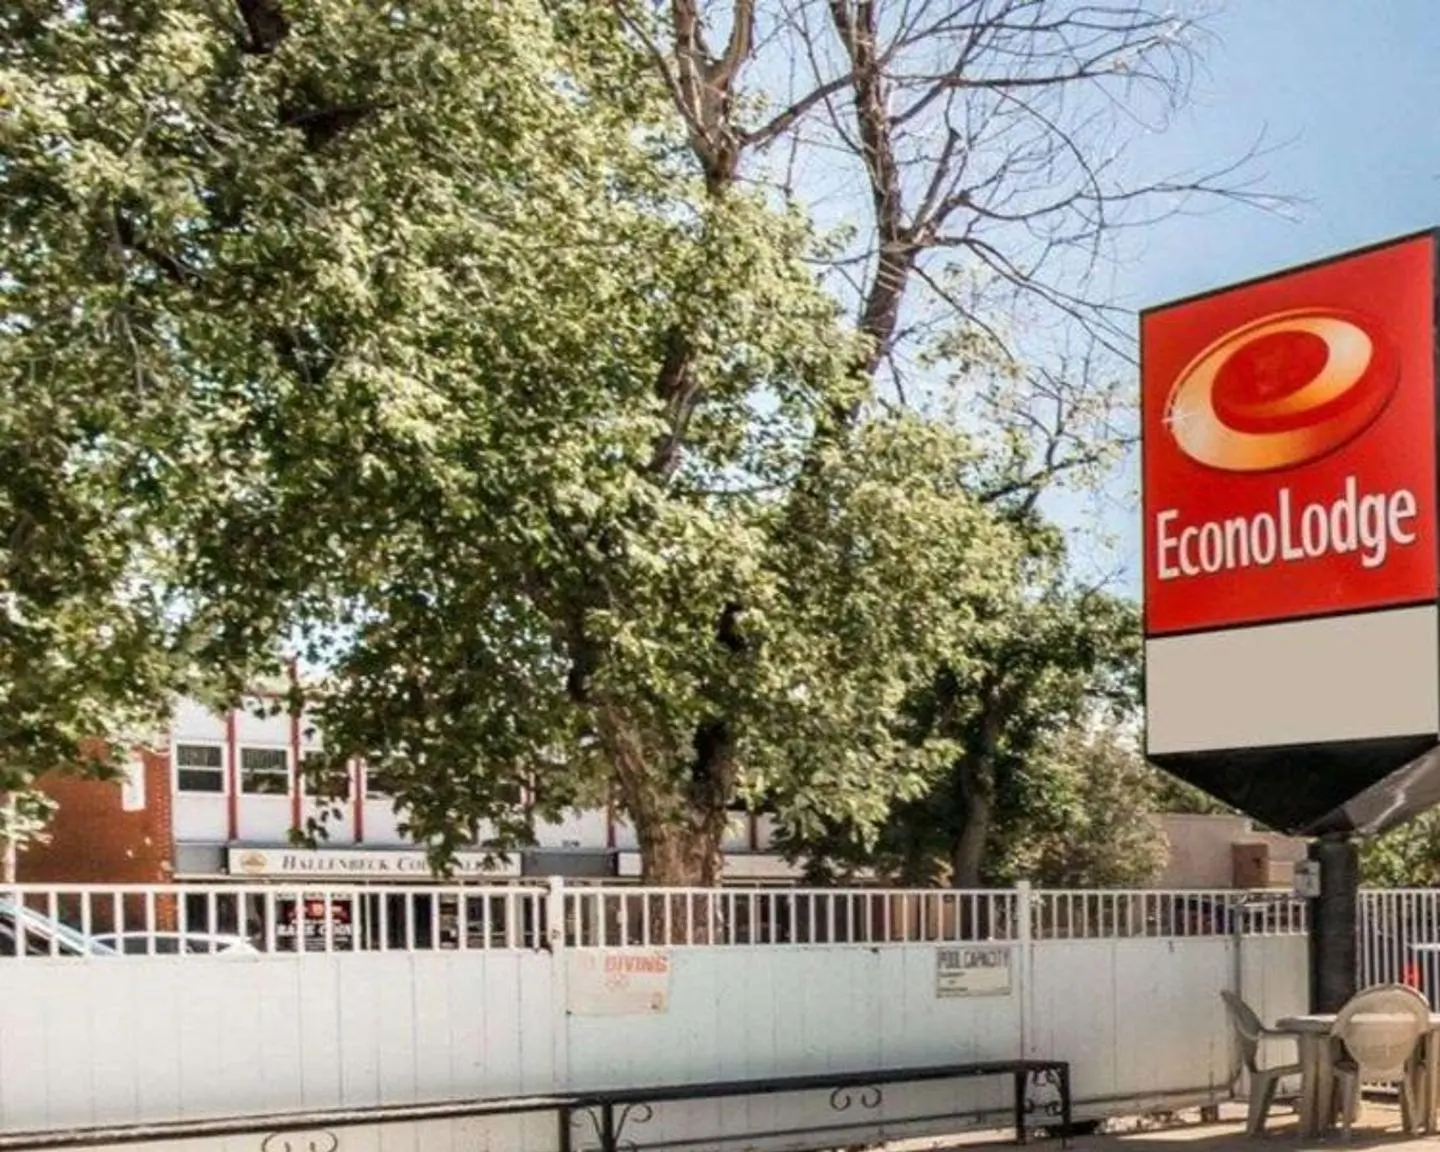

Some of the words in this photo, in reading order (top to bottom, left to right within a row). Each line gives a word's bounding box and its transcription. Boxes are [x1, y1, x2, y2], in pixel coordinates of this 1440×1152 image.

[1156, 475, 1418, 579] EconoLodge
[604, 954, 669, 974] DIVING
[936, 950, 962, 969] POOL
